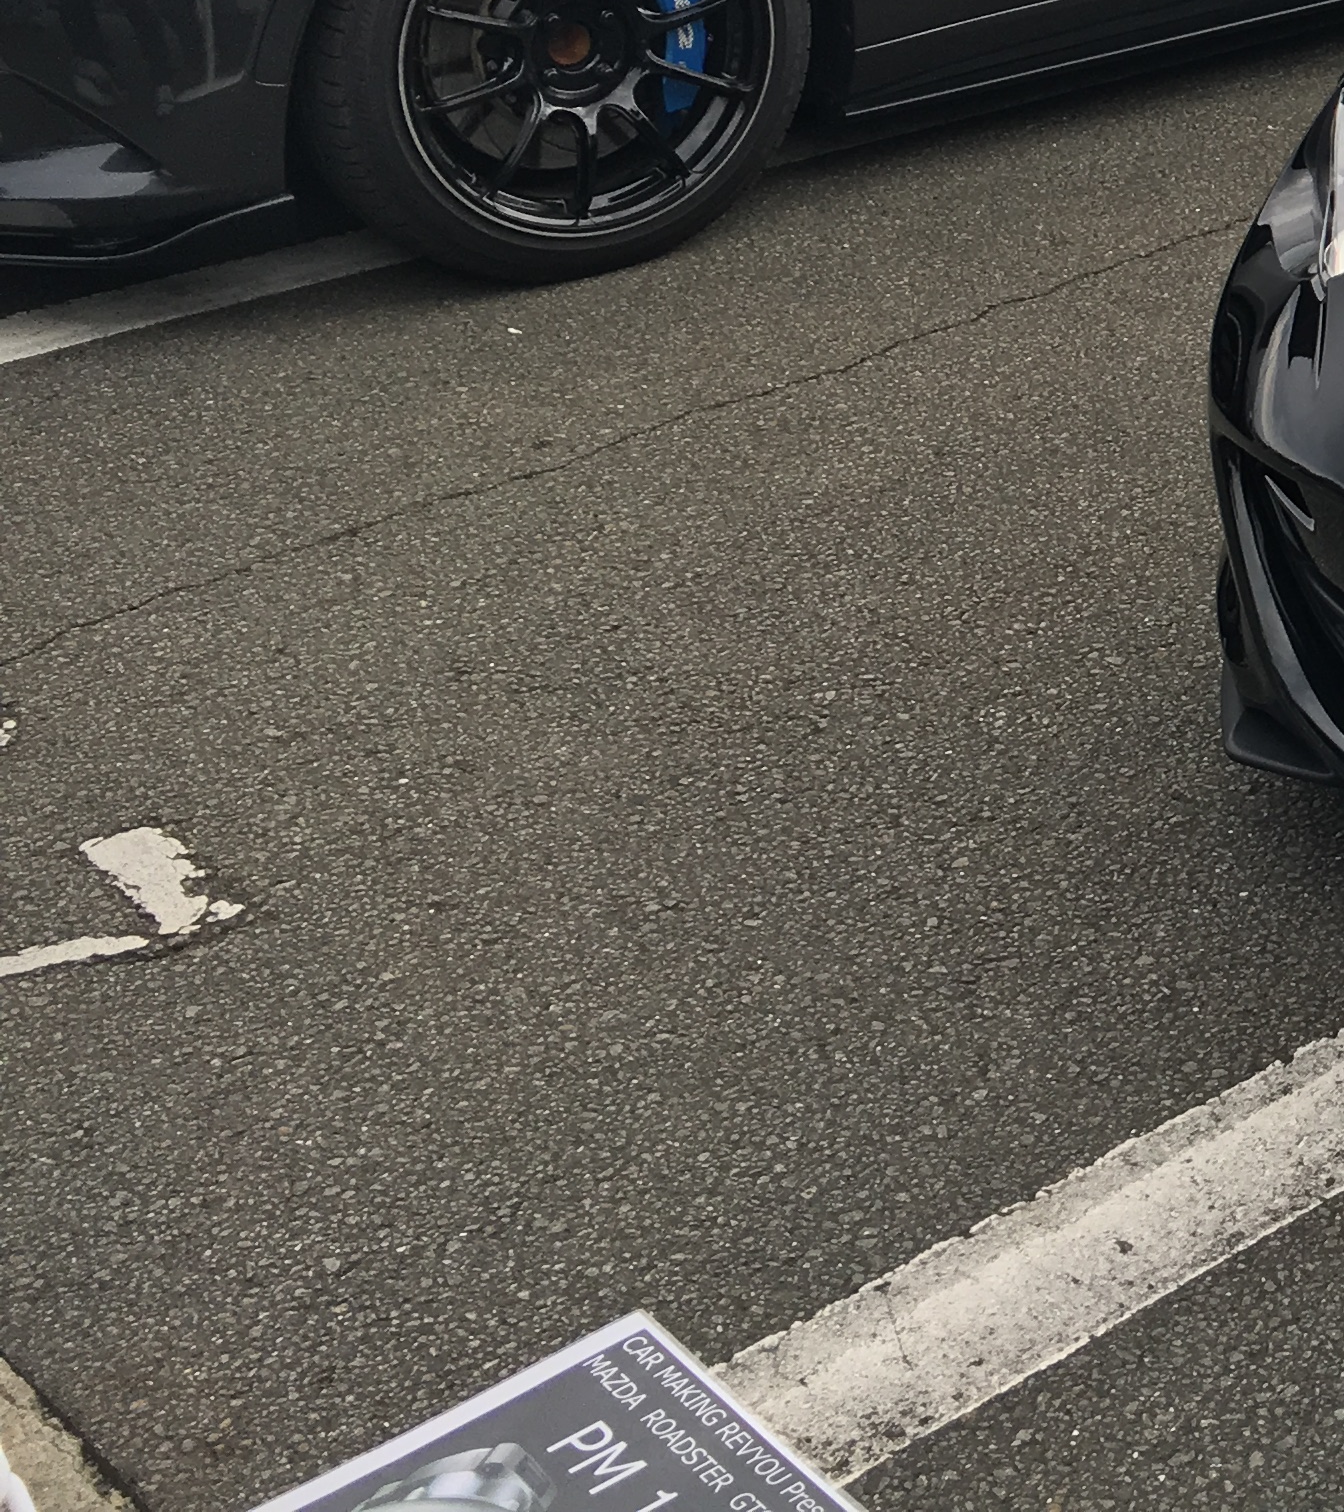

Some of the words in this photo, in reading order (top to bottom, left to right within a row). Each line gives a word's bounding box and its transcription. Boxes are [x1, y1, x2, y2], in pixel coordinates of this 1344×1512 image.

[546, 1419, 648, 1496] PM
[582, 1354, 647, 1411] MAZDA
[640, 1408, 734, 1494] ROADSTER
[622, 1336, 664, 1371] CAR
[653, 1365, 727, 1426] MAKING
[715, 1421, 792, 1487] REVYOU
